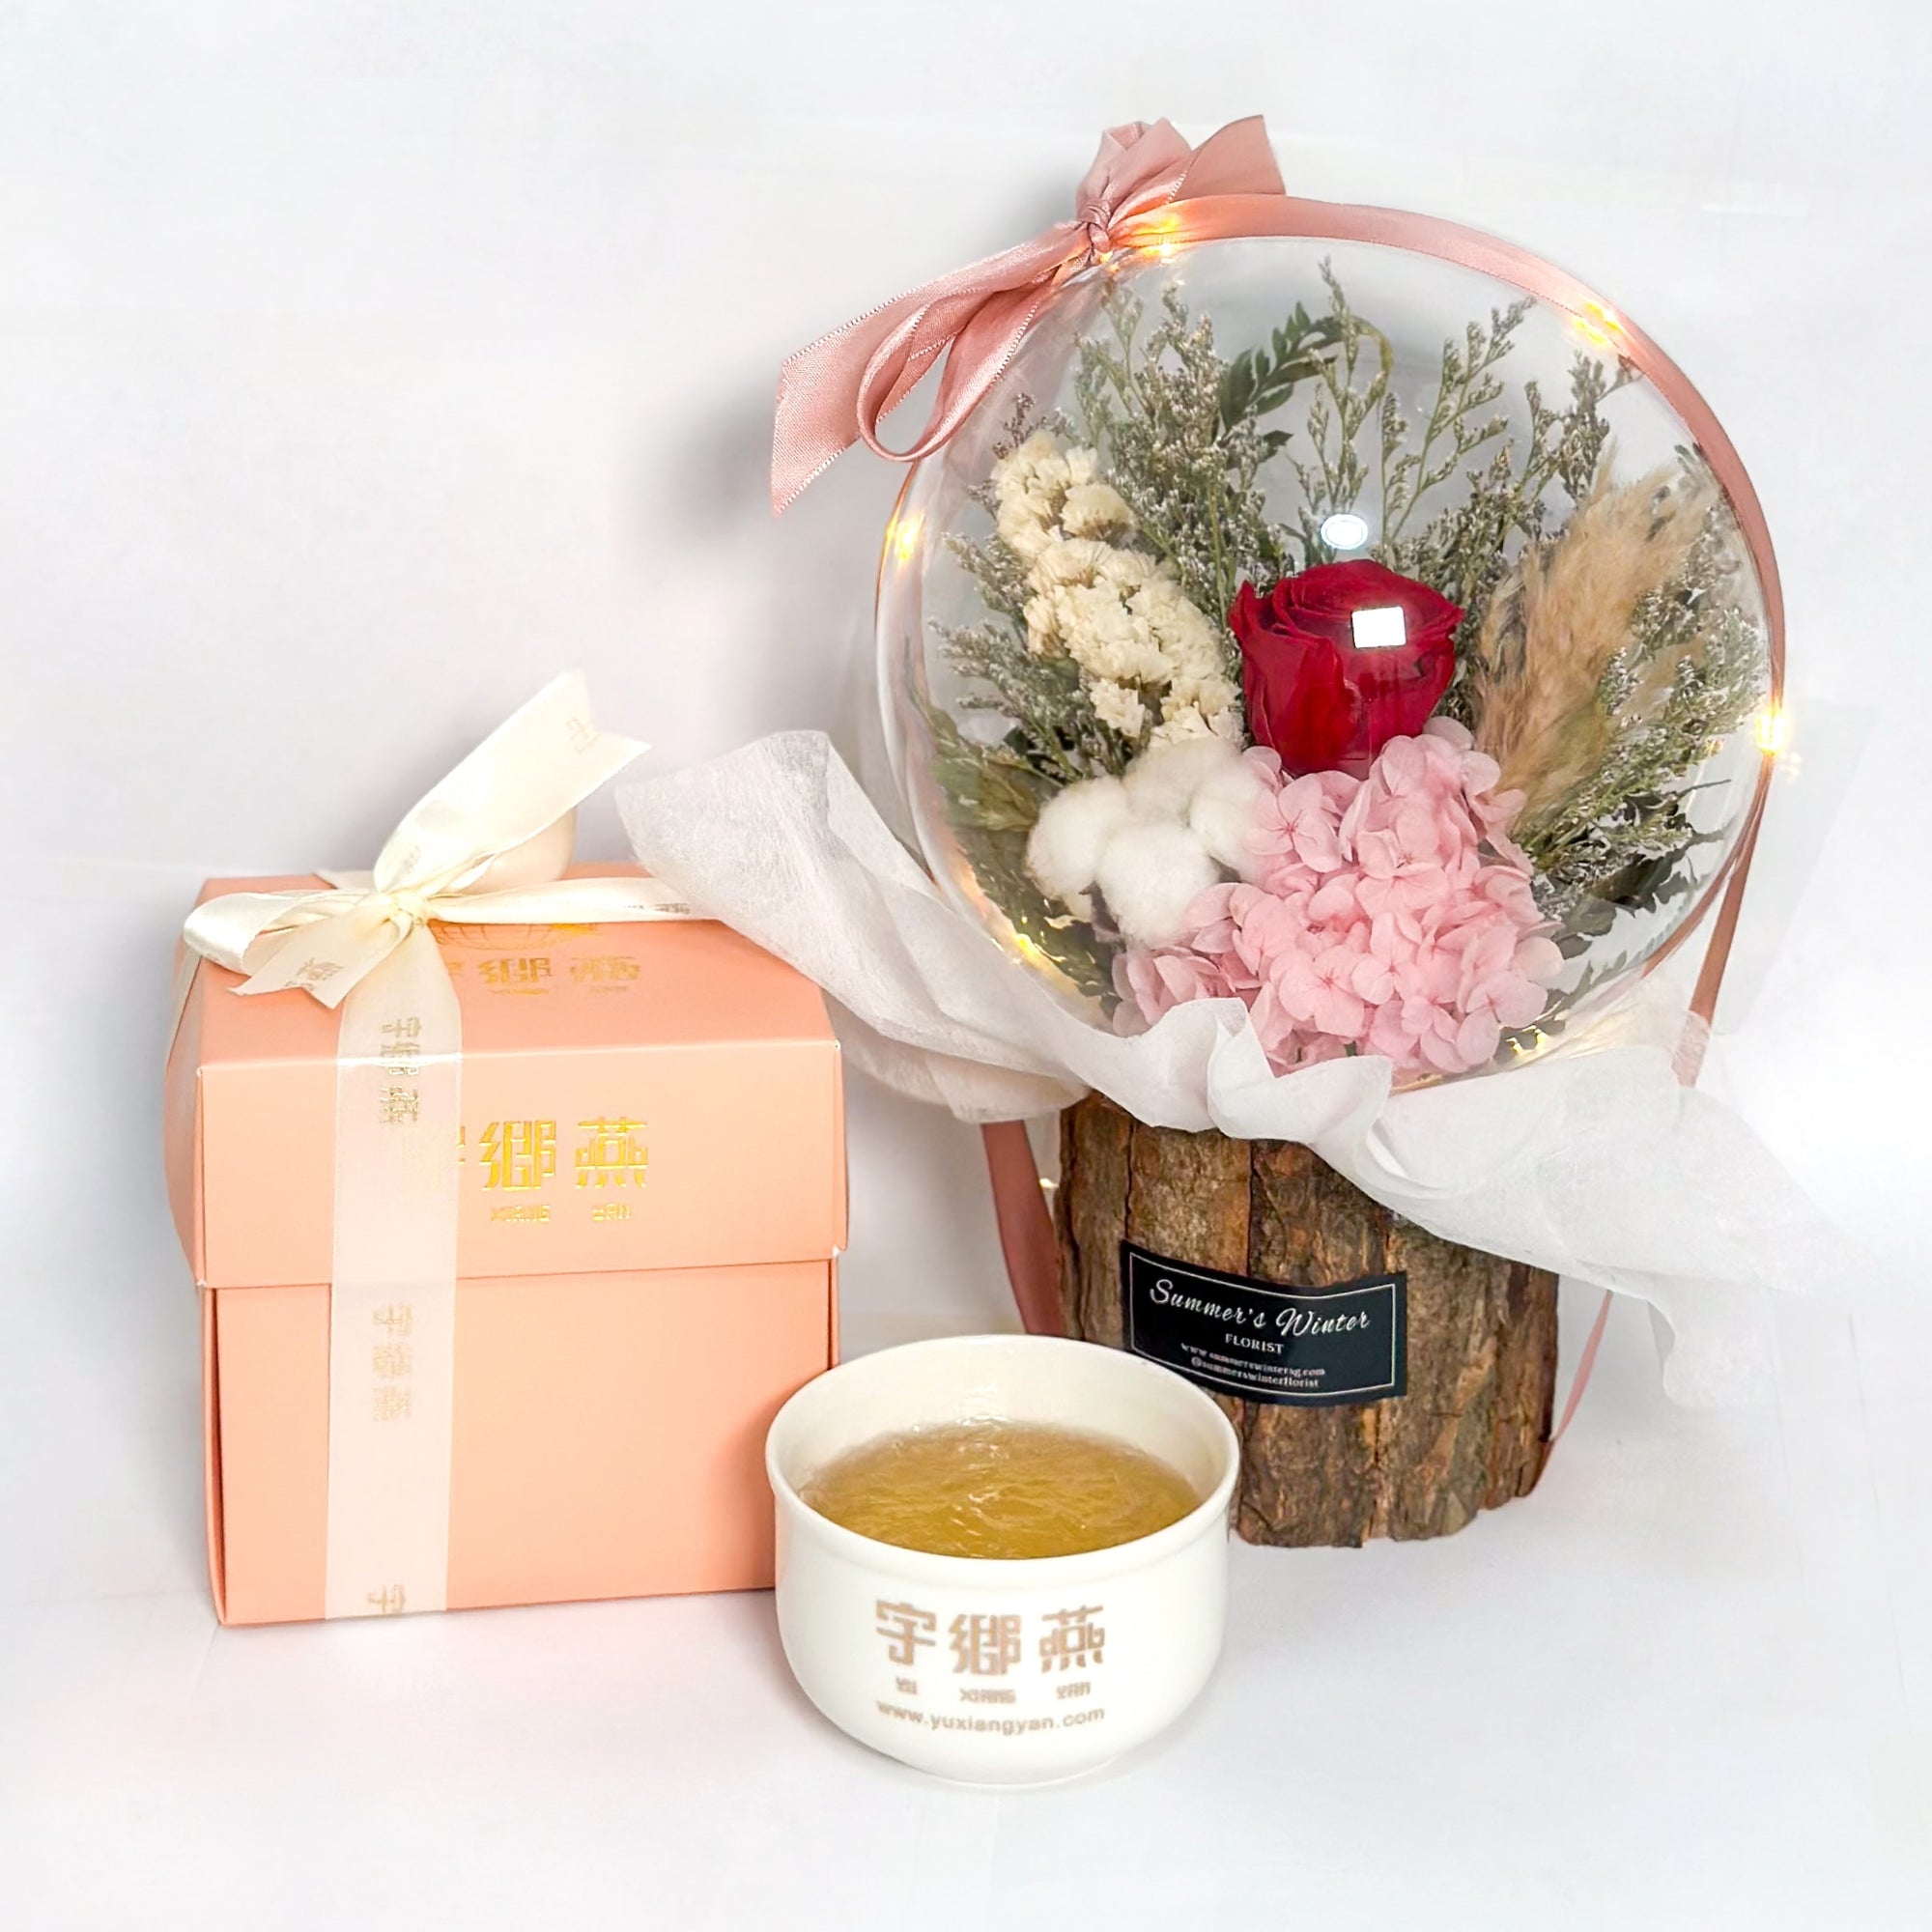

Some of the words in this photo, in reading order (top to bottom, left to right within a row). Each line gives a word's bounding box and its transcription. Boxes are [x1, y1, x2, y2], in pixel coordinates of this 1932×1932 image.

[1150, 1279, 1266, 1329] Summer's
[1276, 1308, 1371, 1337] Winter
[1225, 1333, 1285, 1355] FLORIST
[876, 1700, 1105, 1736] www.yuxiangyan.com
